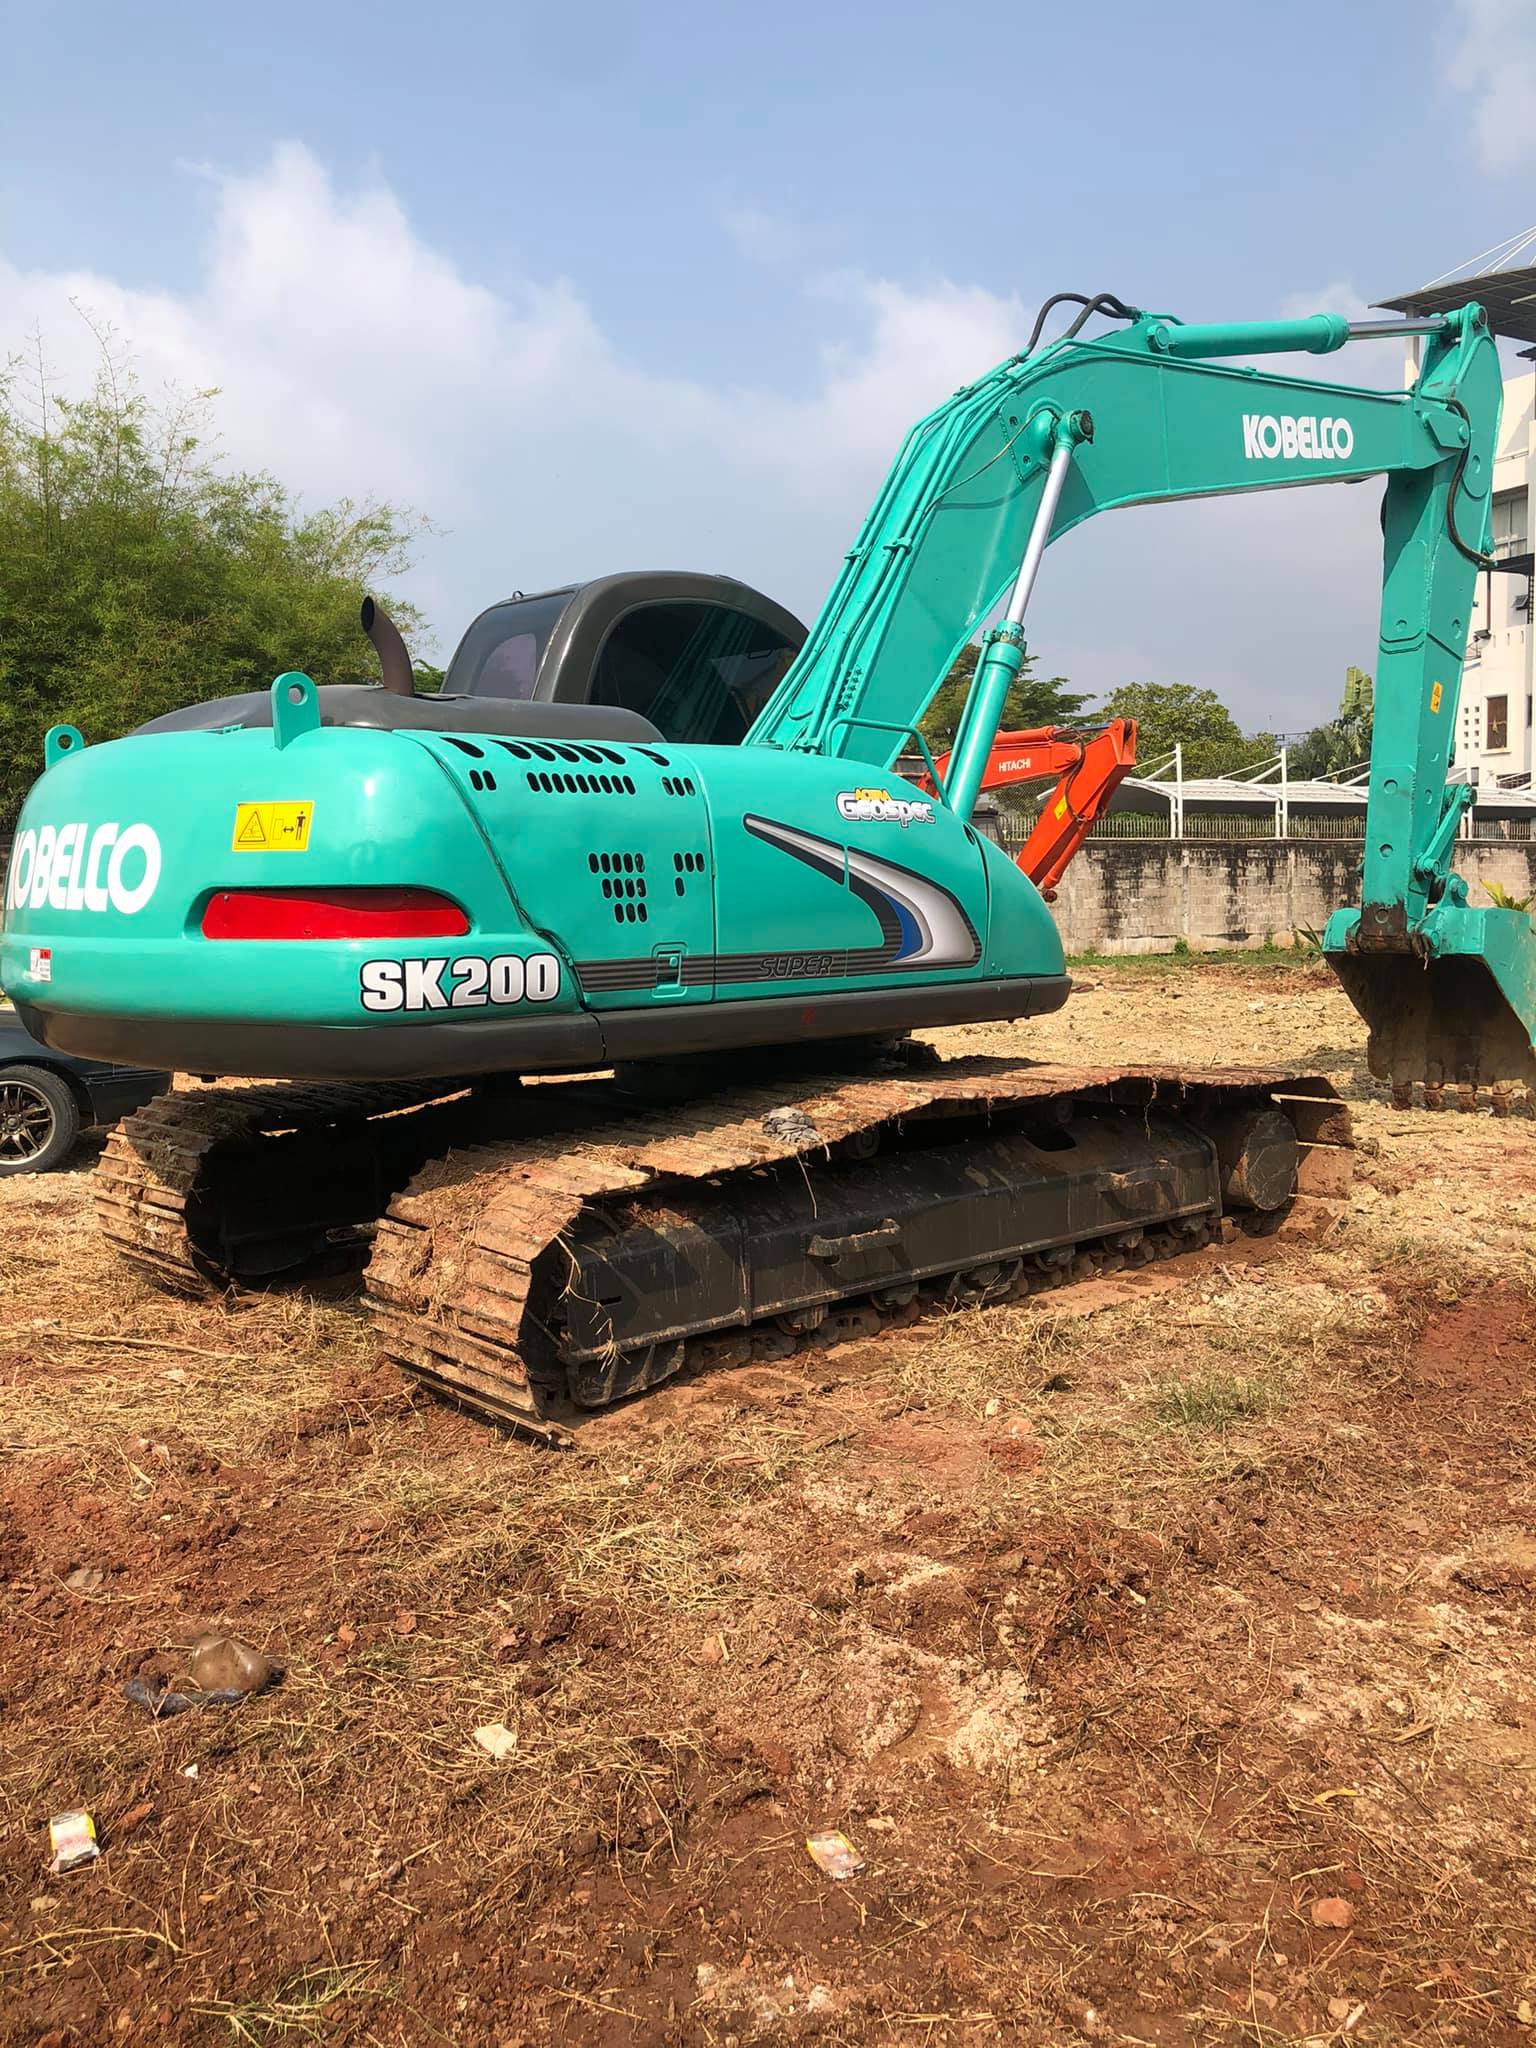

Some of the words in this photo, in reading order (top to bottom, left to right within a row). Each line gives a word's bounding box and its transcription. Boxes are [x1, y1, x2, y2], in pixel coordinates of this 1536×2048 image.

[1242, 414, 1354, 460] KOBELCO
[998, 758, 1031, 772] HITACHI
[360, 952, 561, 1012] SK200
[761, 956, 833, 977] SUPER
